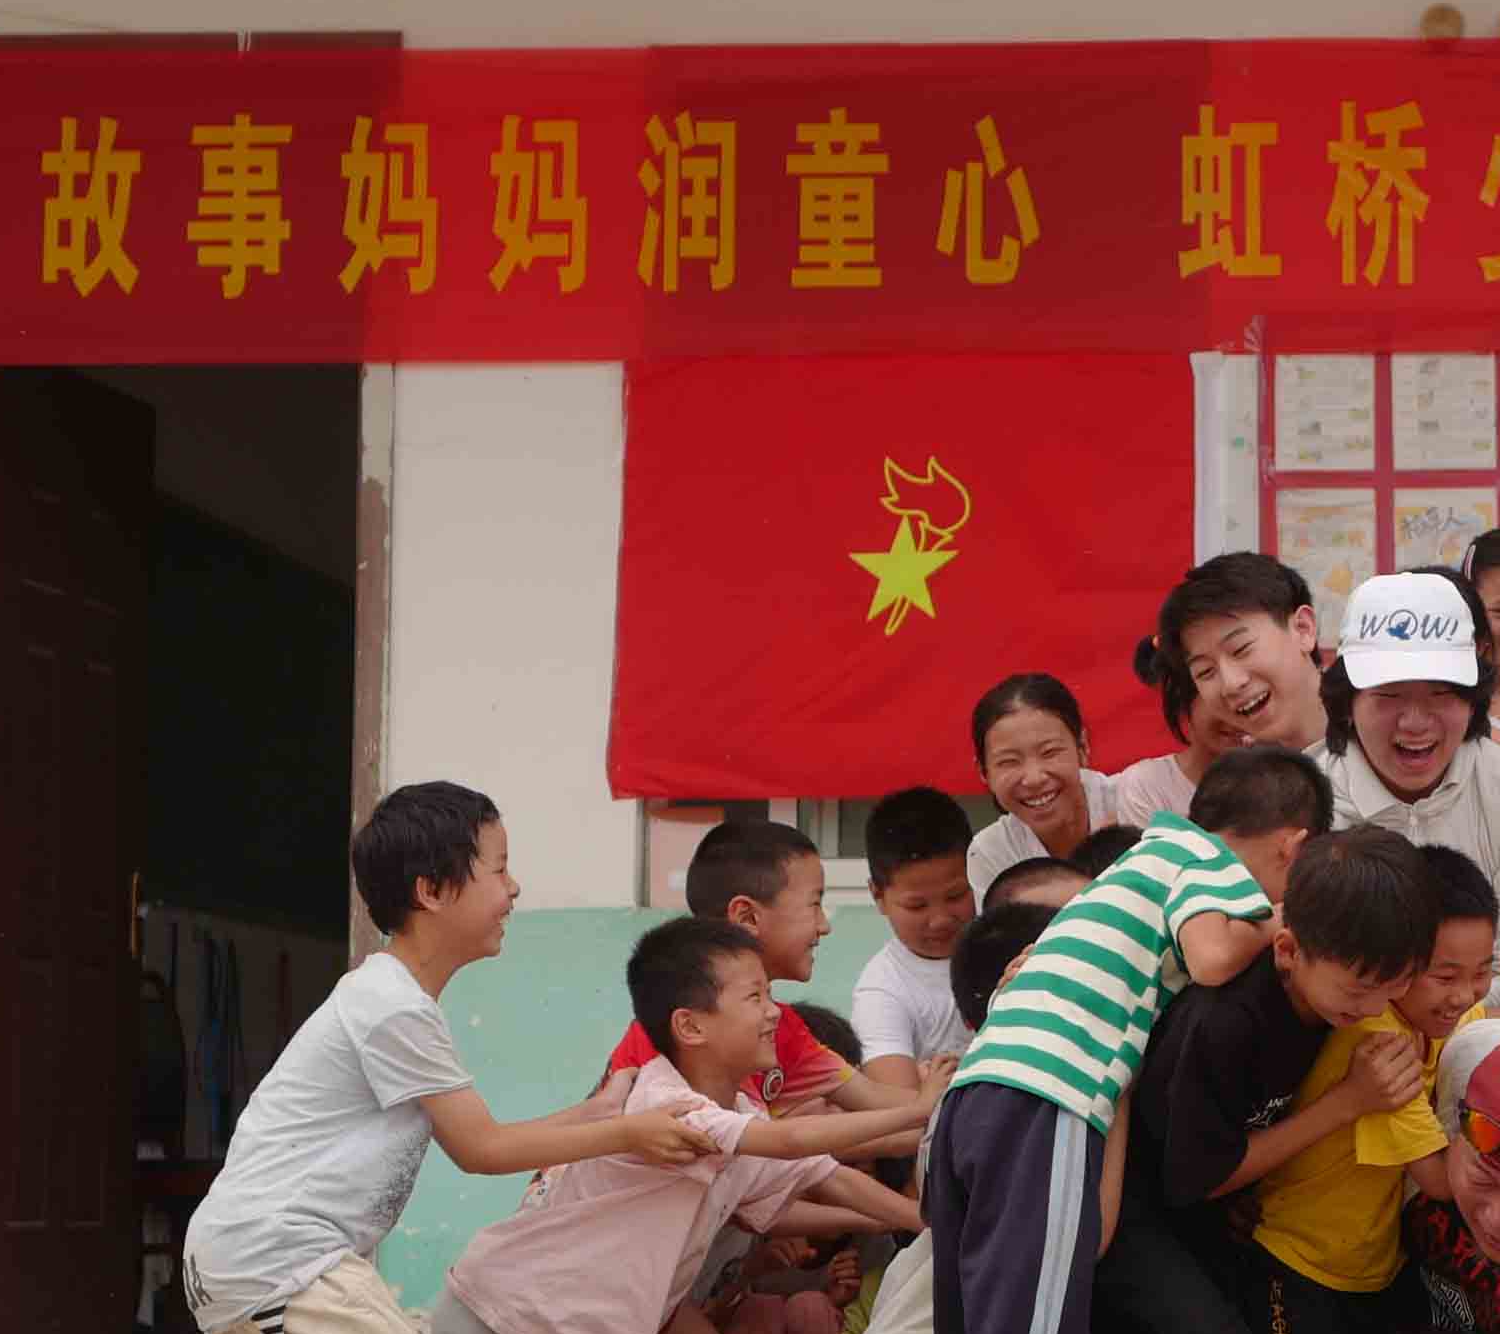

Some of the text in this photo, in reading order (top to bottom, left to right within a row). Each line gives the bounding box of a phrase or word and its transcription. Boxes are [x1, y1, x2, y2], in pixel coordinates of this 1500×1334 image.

[40, 108, 1041, 299] 故事妈妈润童心
